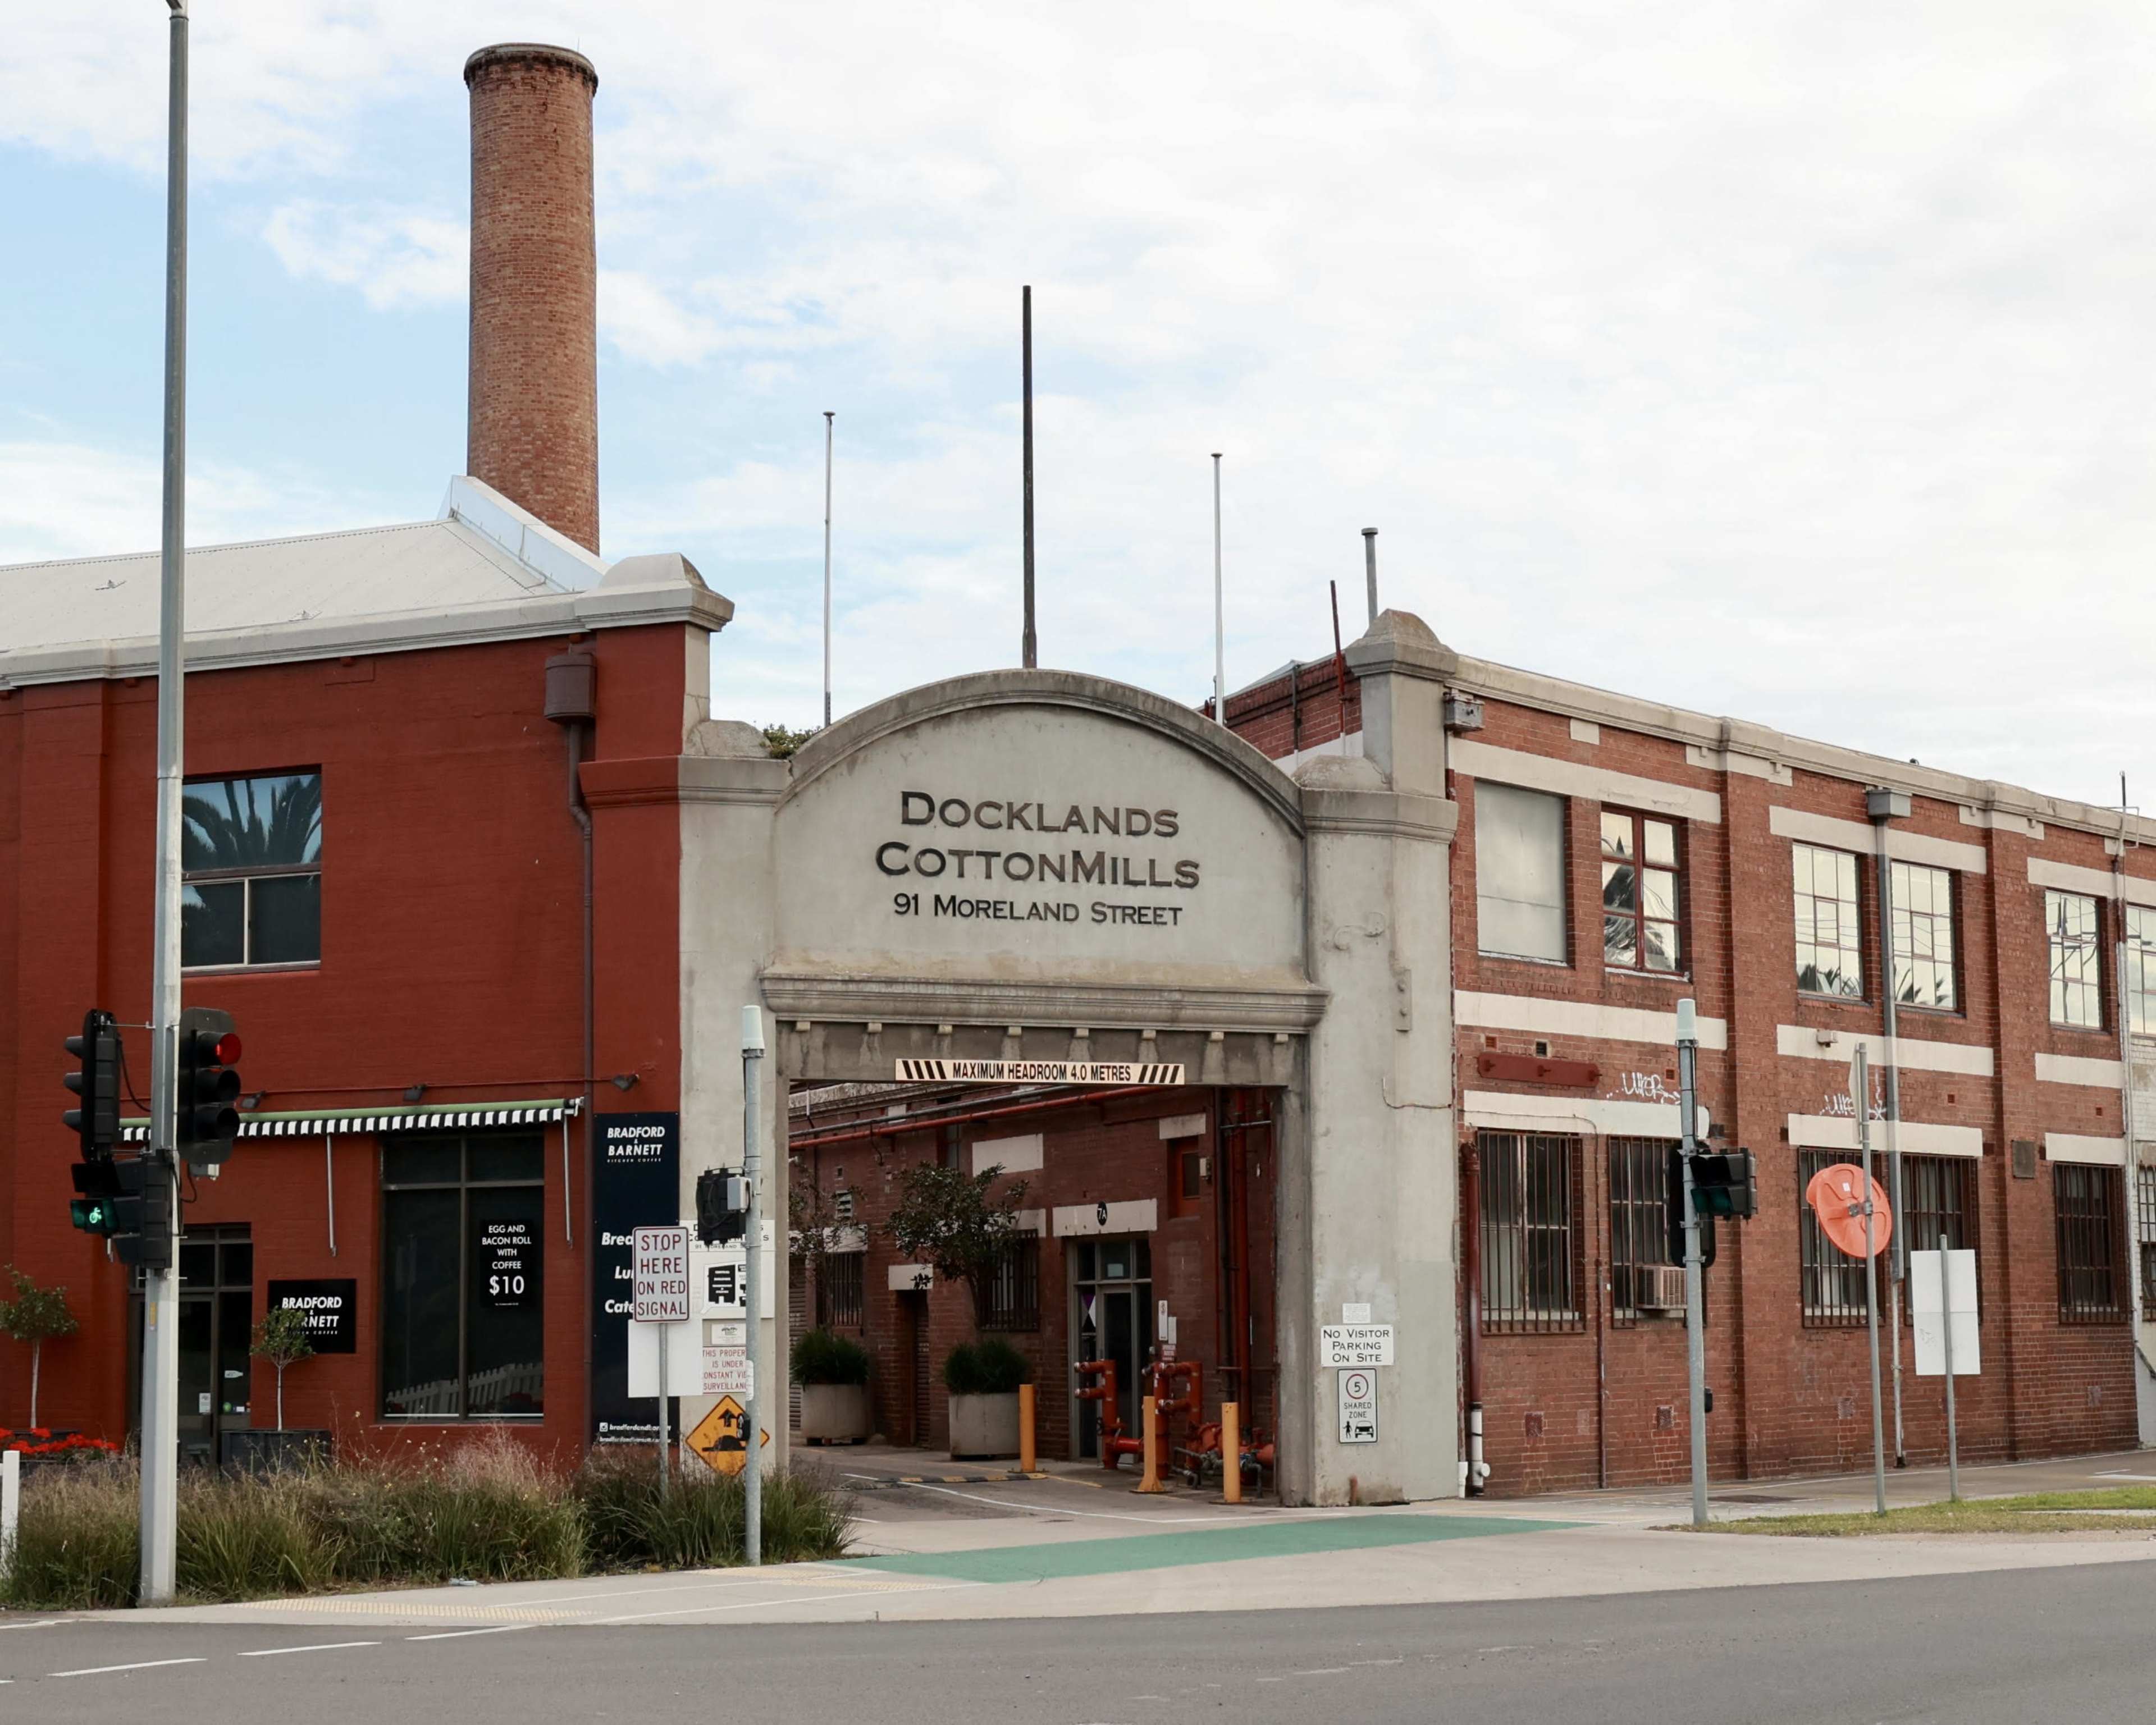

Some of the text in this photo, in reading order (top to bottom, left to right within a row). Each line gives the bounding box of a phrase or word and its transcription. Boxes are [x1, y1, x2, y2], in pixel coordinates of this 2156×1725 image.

[901, 791, 1179, 838] DOCKLANDS
[894, 893, 1182, 926] 91 MORELAND STREET
[953, 1062, 1131, 1081] MAXIMUM HEADROOM 4.0 METRES
[607, 1126, 665, 1138] BRADFORD
[608, 1144, 663, 1156] BARNETT
[1098, 1208, 1107, 1219] 7A
[488, 1225, 505, 1233] EGG
[641, 1234, 682, 1251] STOP
[641, 1257, 683, 1274] HERE
[489, 1275, 524, 1296] $10
[637, 1280, 686, 1296] ON RED
[281, 1297, 342, 1309] BRADFORD
[637, 1300, 687, 1316] SIGNAL
[301, 1316, 340, 1328] RNETT
[1323, 1329, 1390, 1339] NO VISITOR
[1332, 1341, 1382, 1350] PARKING
[1332, 1353, 1382, 1362] ON SITE
[1354, 1381, 1361, 1392] 5
